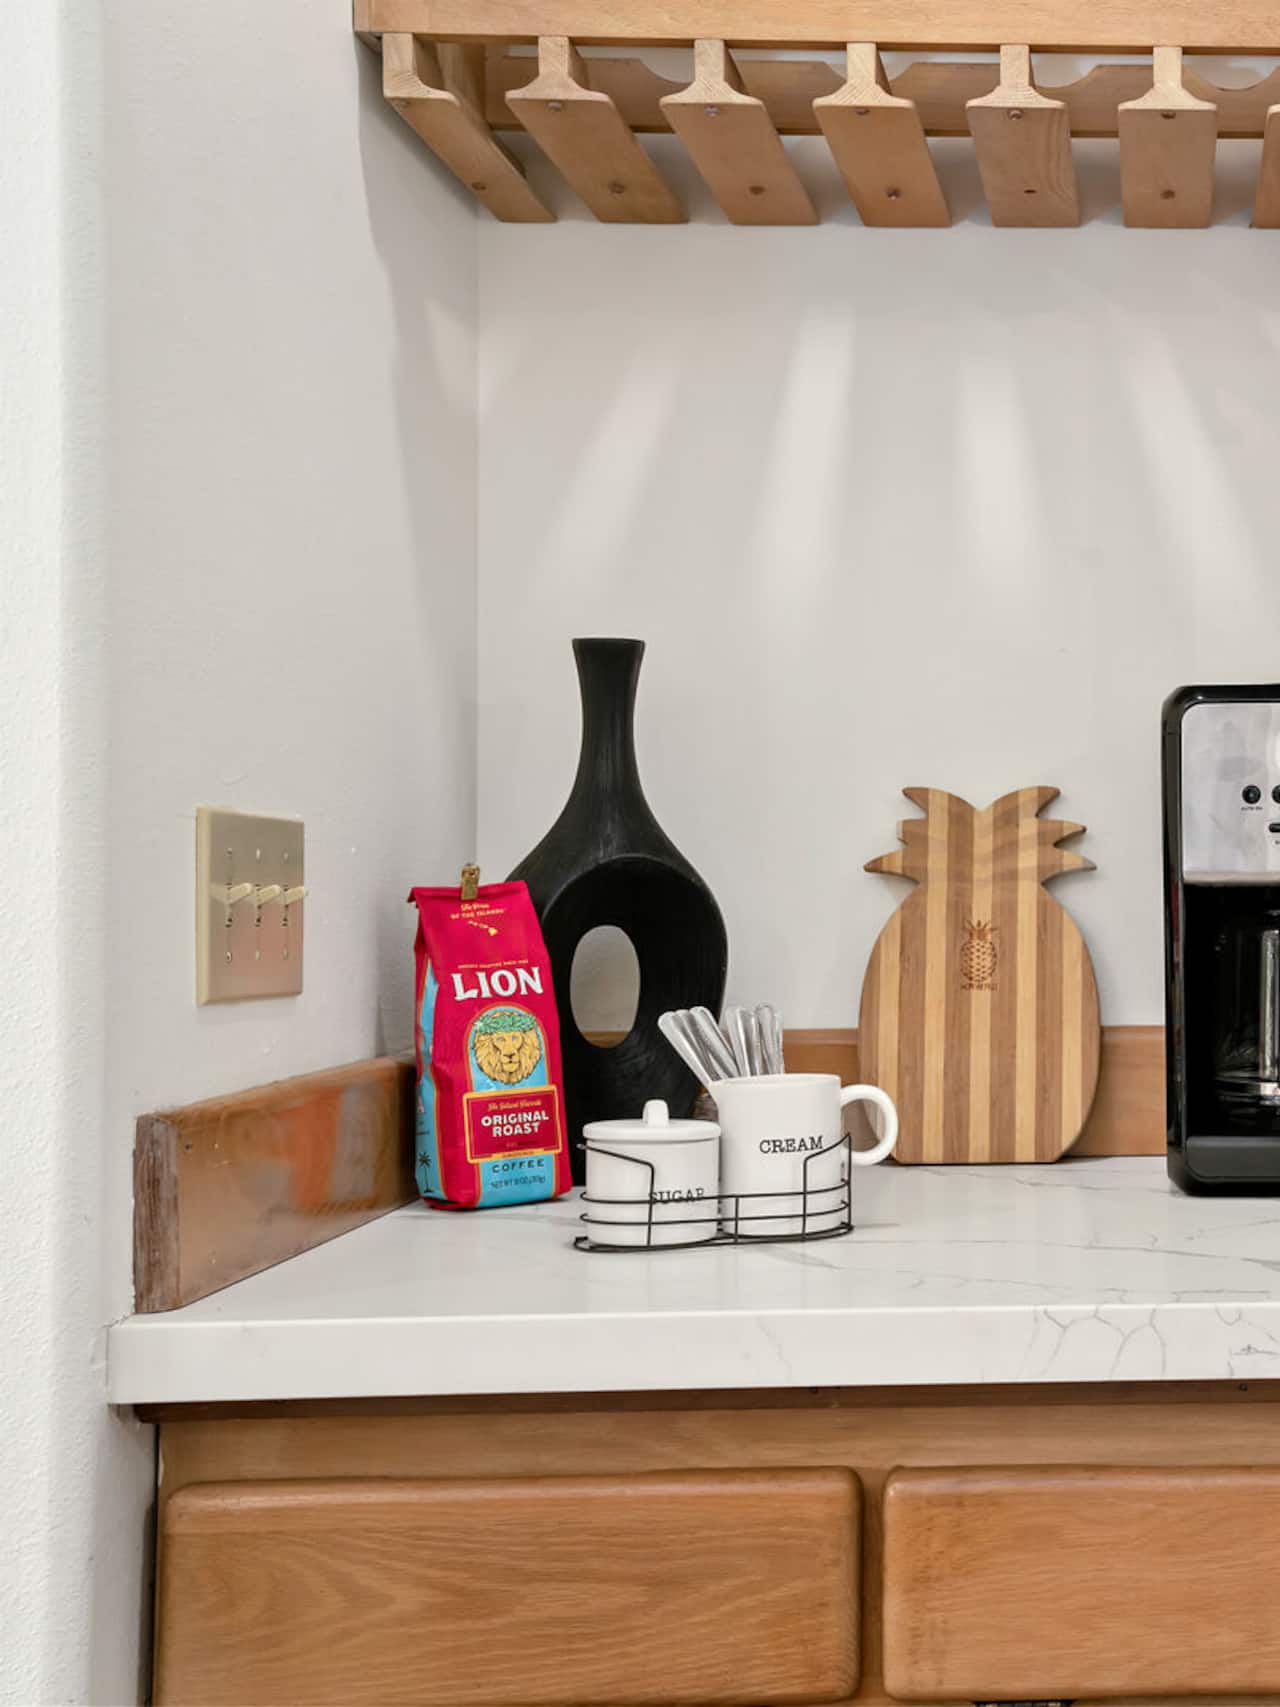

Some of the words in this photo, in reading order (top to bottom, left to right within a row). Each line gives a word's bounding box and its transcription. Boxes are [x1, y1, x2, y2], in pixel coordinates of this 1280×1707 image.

[450, 966, 544, 1001] LION
[481, 1110, 549, 1127] ORIGINAL
[492, 1121, 540, 1137] ROAST
[759, 1135, 823, 1154] CREAM
[492, 1158, 545, 1173] COFFEE
